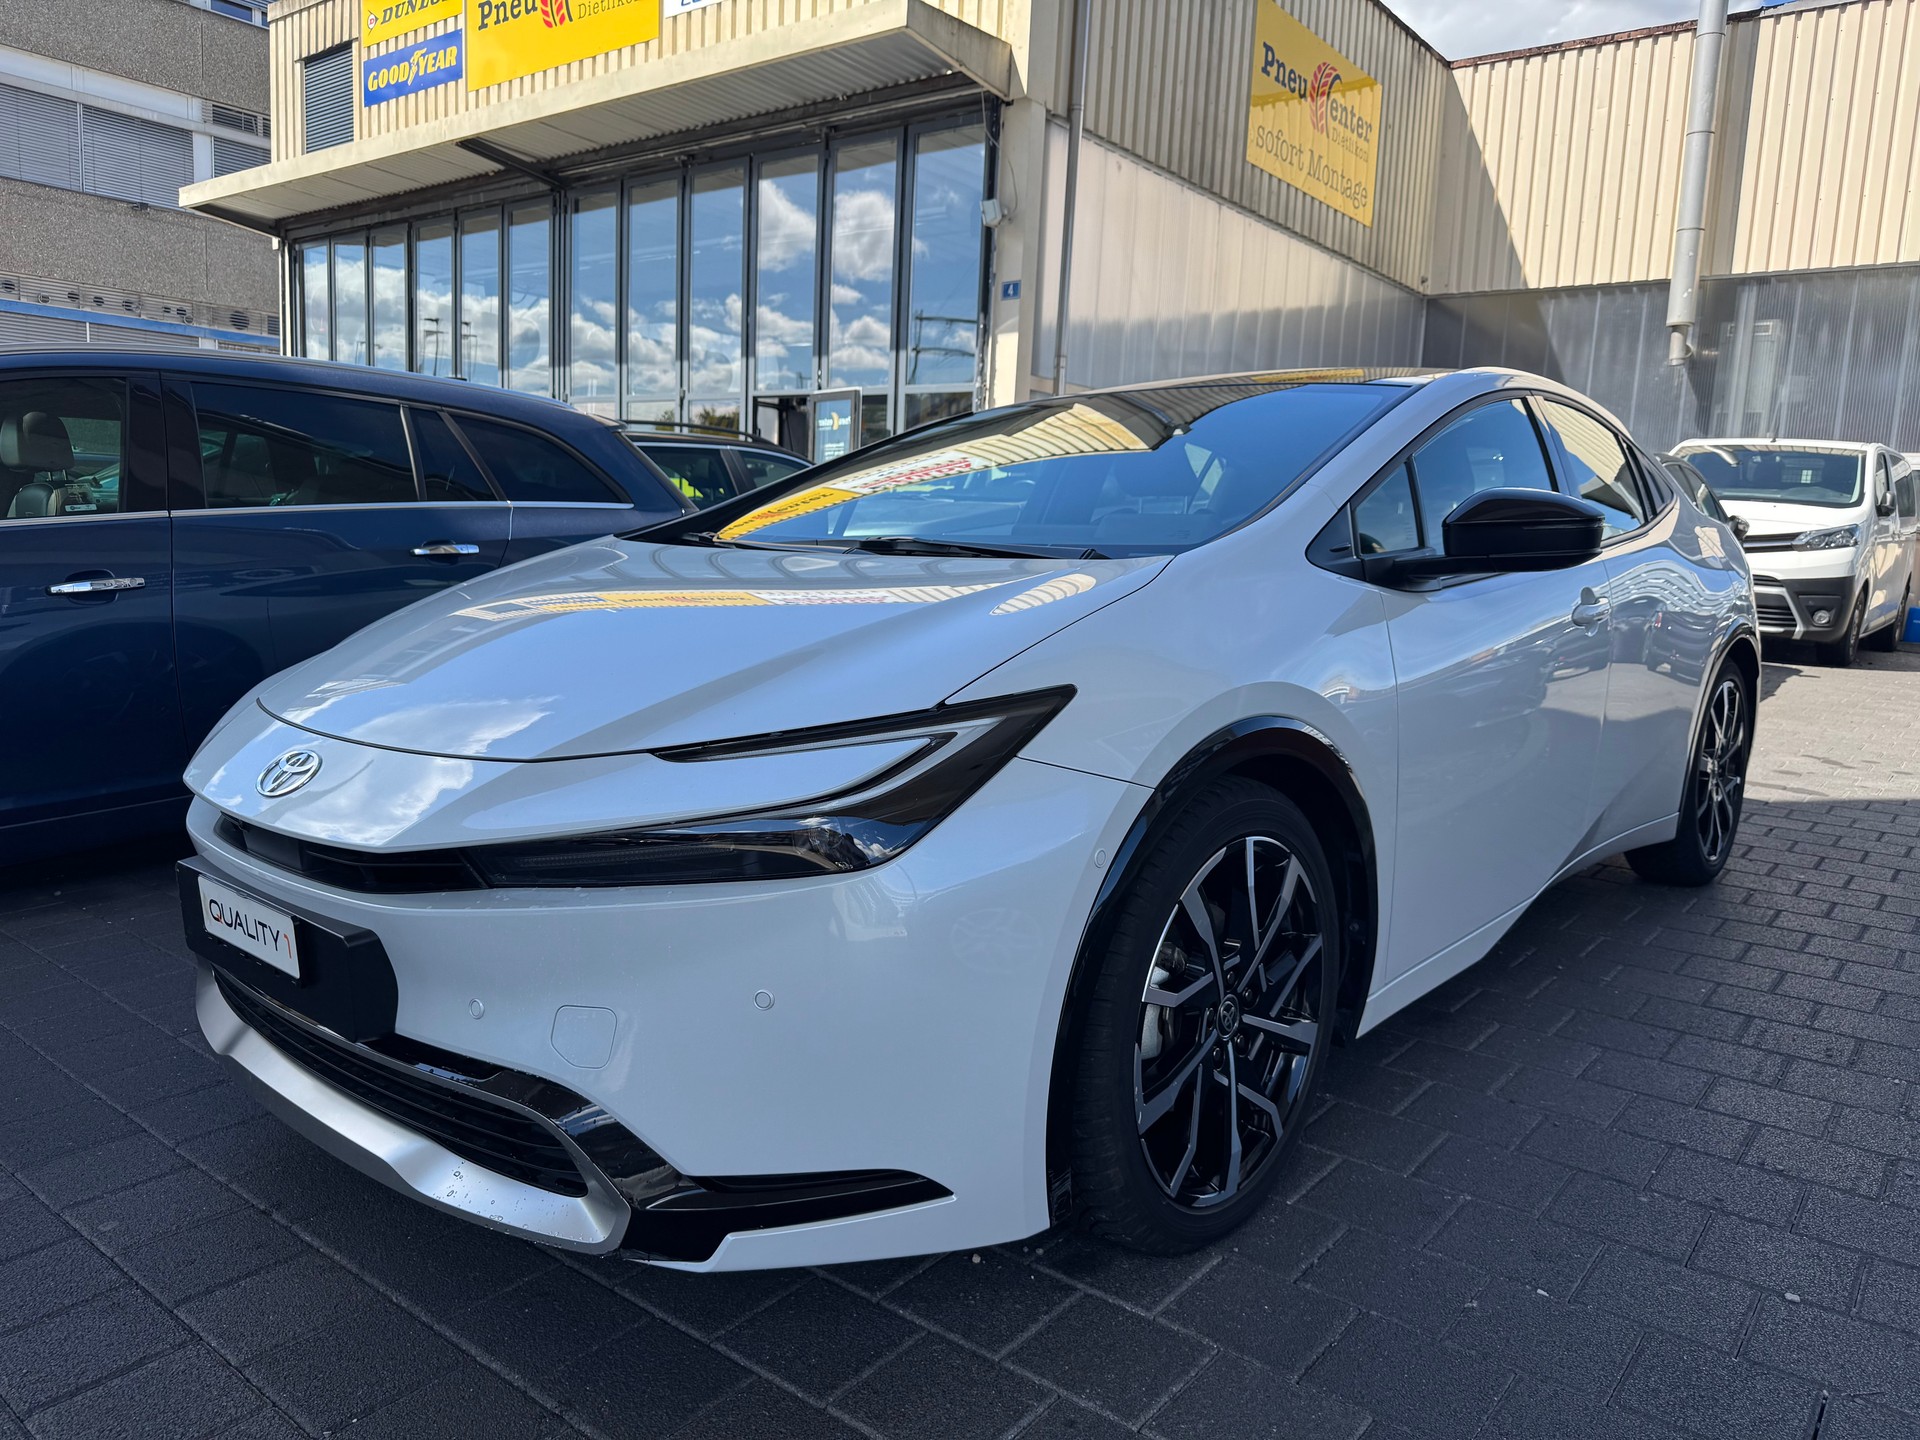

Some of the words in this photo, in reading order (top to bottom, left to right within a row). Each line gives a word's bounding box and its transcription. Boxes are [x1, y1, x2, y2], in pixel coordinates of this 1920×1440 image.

[380, 0, 447, 25] DUNL
[477, 0, 538, 31] Pneu
[367, 46, 458, 92] GOODYEAR
[1261, 41, 1308, 102] Pneu
[1307, 148, 1368, 210] Montage
